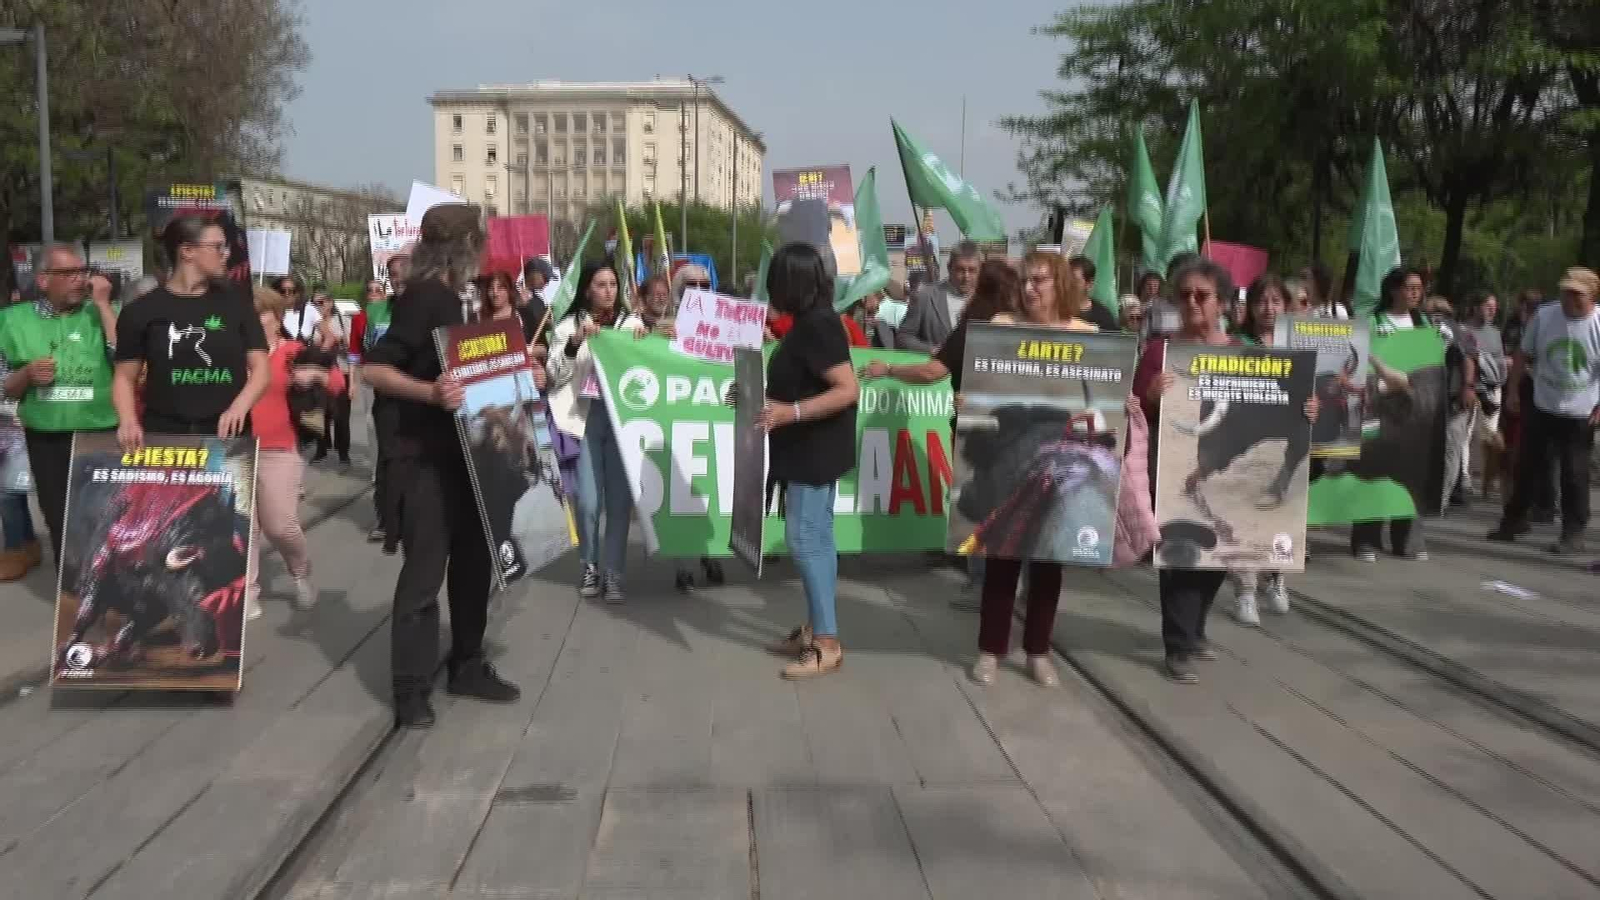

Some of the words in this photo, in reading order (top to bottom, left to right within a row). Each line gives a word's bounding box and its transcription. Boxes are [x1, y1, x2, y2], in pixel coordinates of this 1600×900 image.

[1017, 340, 1084, 363] ¿ARTE?
[974, 356, 988, 372] ES
[990, 358, 1044, 377] TORTURA,
[1045, 363, 1059, 377] ES
[1061, 364, 1122, 382] ASESINATO
[1190, 353, 1292, 378] ¿TRADICIÓN?
[172, 368, 233, 386] PACMA
[1198, 375, 1211, 387] ES
[859, 386, 890, 414] IDO
[895, 388, 956, 417] ANIMA
[1187, 387, 1202, 400] ES
[1203, 389, 1242, 402] MUERTE
[1243, 390, 1289, 405] VIOLENTA
[121, 446, 209, 467] ¿FIESTA?
[92, 468, 109, 482] ES
[170, 471, 187, 485] ES
